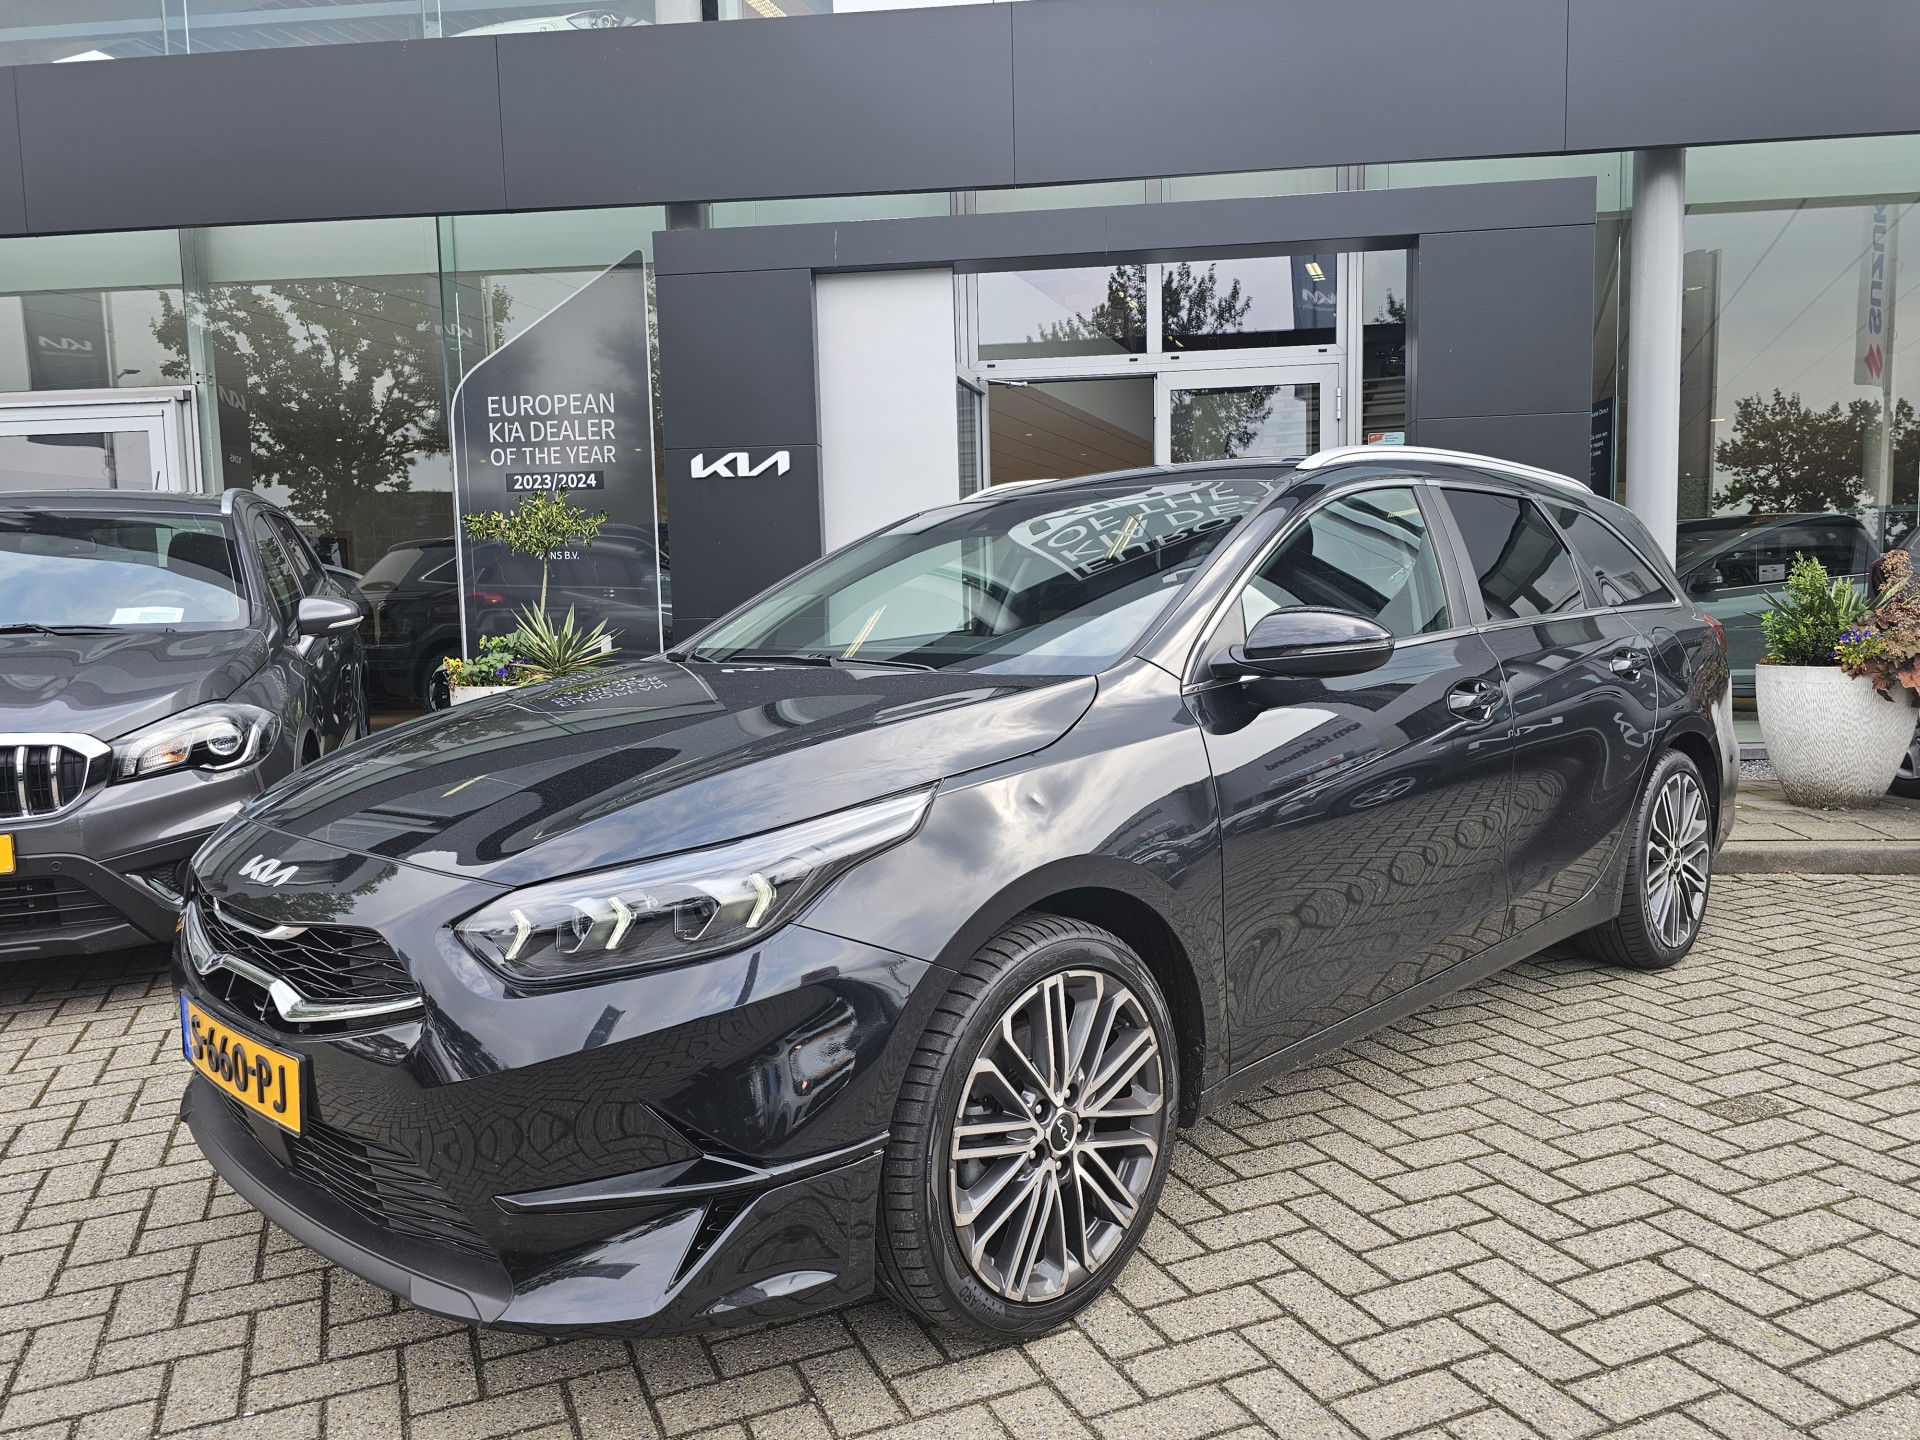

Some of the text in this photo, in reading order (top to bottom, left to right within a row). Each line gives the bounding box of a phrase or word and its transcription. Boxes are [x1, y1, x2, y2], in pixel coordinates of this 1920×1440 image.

[487, 393, 615, 417] EUROPEAN
[489, 419, 616, 443] KIA DEALER
[490, 445, 616, 466] OF THE YEAR
[691, 450, 790, 478] KIA
[513, 473, 597, 491] 2023/2024
[564, 551, 580, 560] B.V.
[238, 854, 300, 888] KIA
[190, 1014, 288, 1113] S-660-PJ
